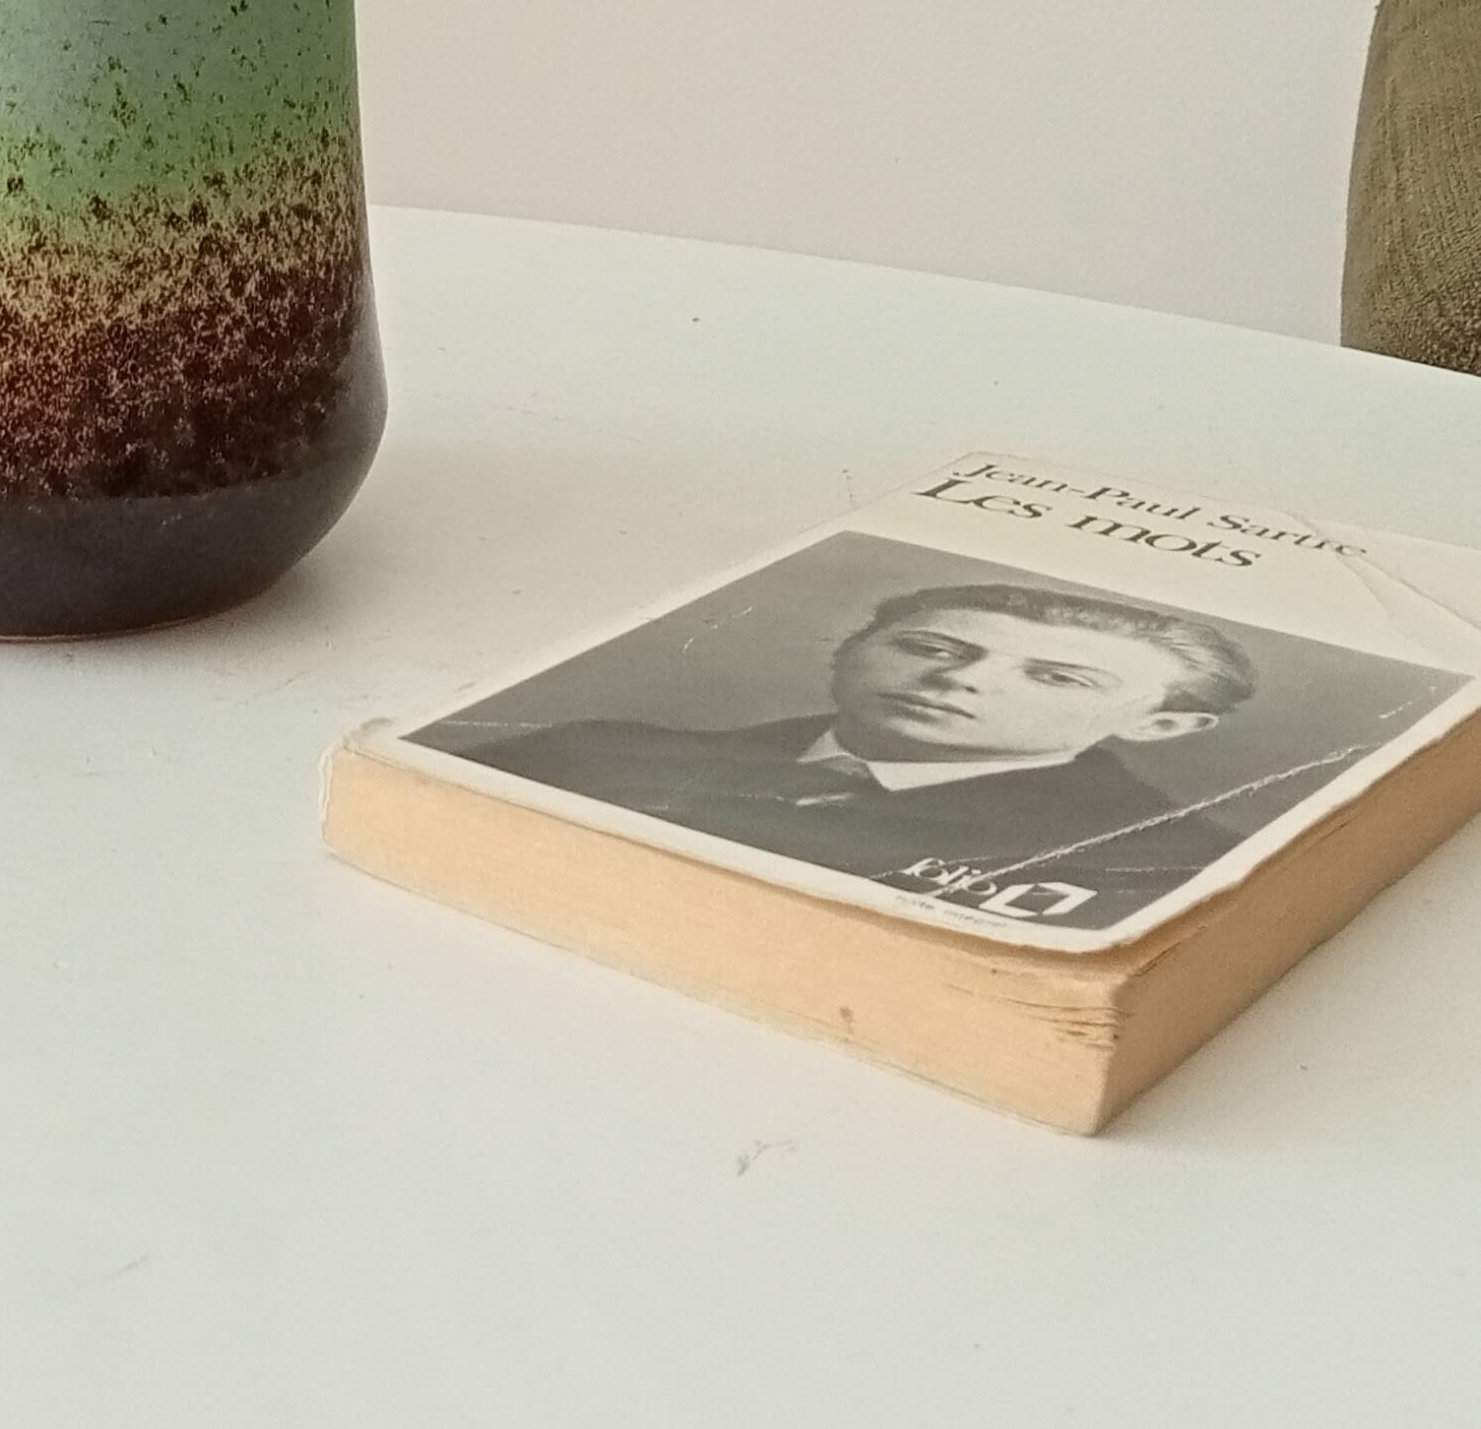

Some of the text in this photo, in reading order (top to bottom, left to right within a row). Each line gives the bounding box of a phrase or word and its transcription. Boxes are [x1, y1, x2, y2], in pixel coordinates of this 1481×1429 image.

[911, 478, 1262, 568] Les mots
[952, 463, 1368, 557] Jean-Paul Sartre
